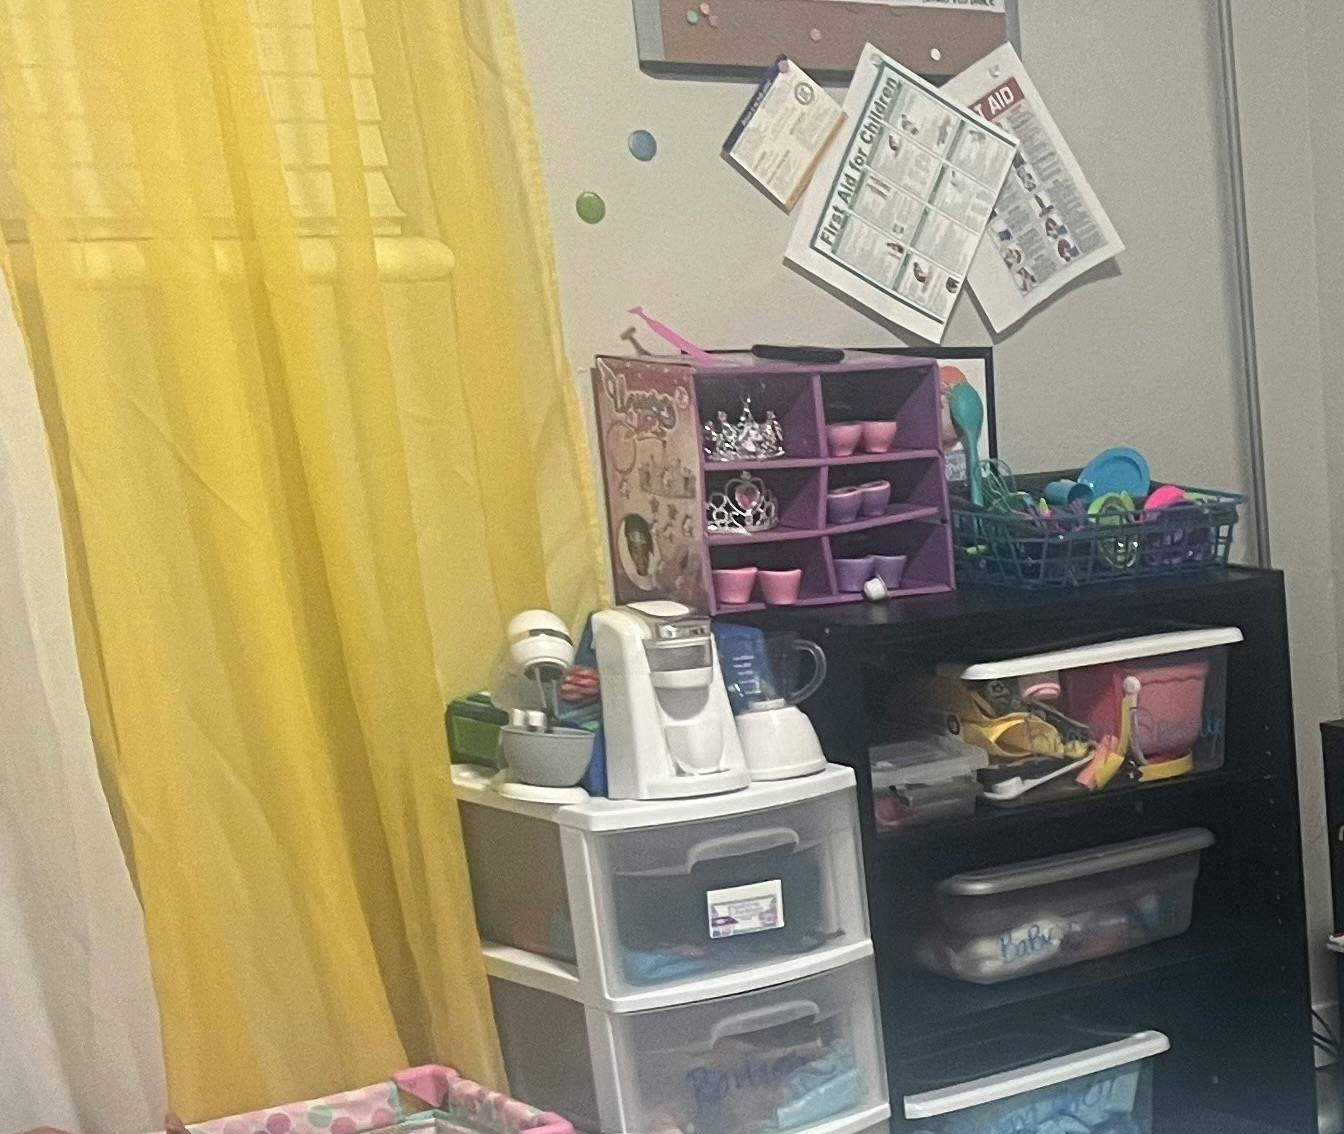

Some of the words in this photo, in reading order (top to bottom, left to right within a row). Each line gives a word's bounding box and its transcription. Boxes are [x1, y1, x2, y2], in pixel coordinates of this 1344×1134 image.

[987, 85, 1015, 117] AID
[821, 205, 846, 247] First
[836, 172, 858, 207] Aid
[848, 146, 867, 173] for
[860, 77, 898, 143] Children
